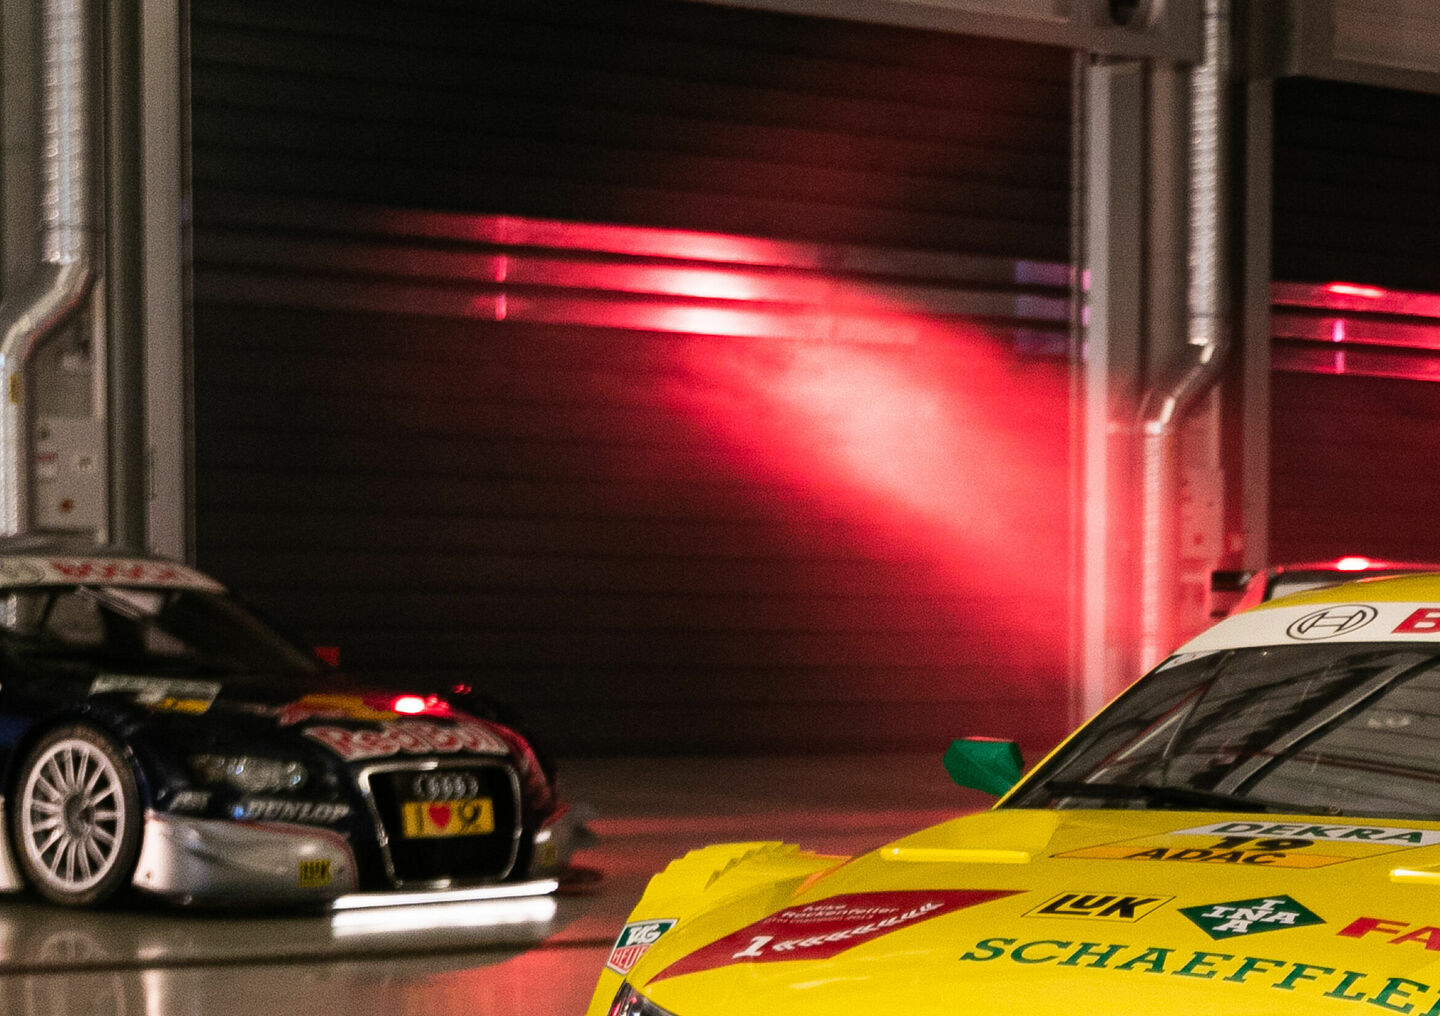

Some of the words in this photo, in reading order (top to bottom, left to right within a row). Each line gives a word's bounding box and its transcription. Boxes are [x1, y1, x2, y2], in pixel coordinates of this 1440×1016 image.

[1208, 836, 1315, 851] 19
[1211, 822, 1424, 844] DEKRA
[1126, 847, 1287, 865] ADAC
[626, 923, 662, 947] TAG
[732, 936, 771, 960] 1
